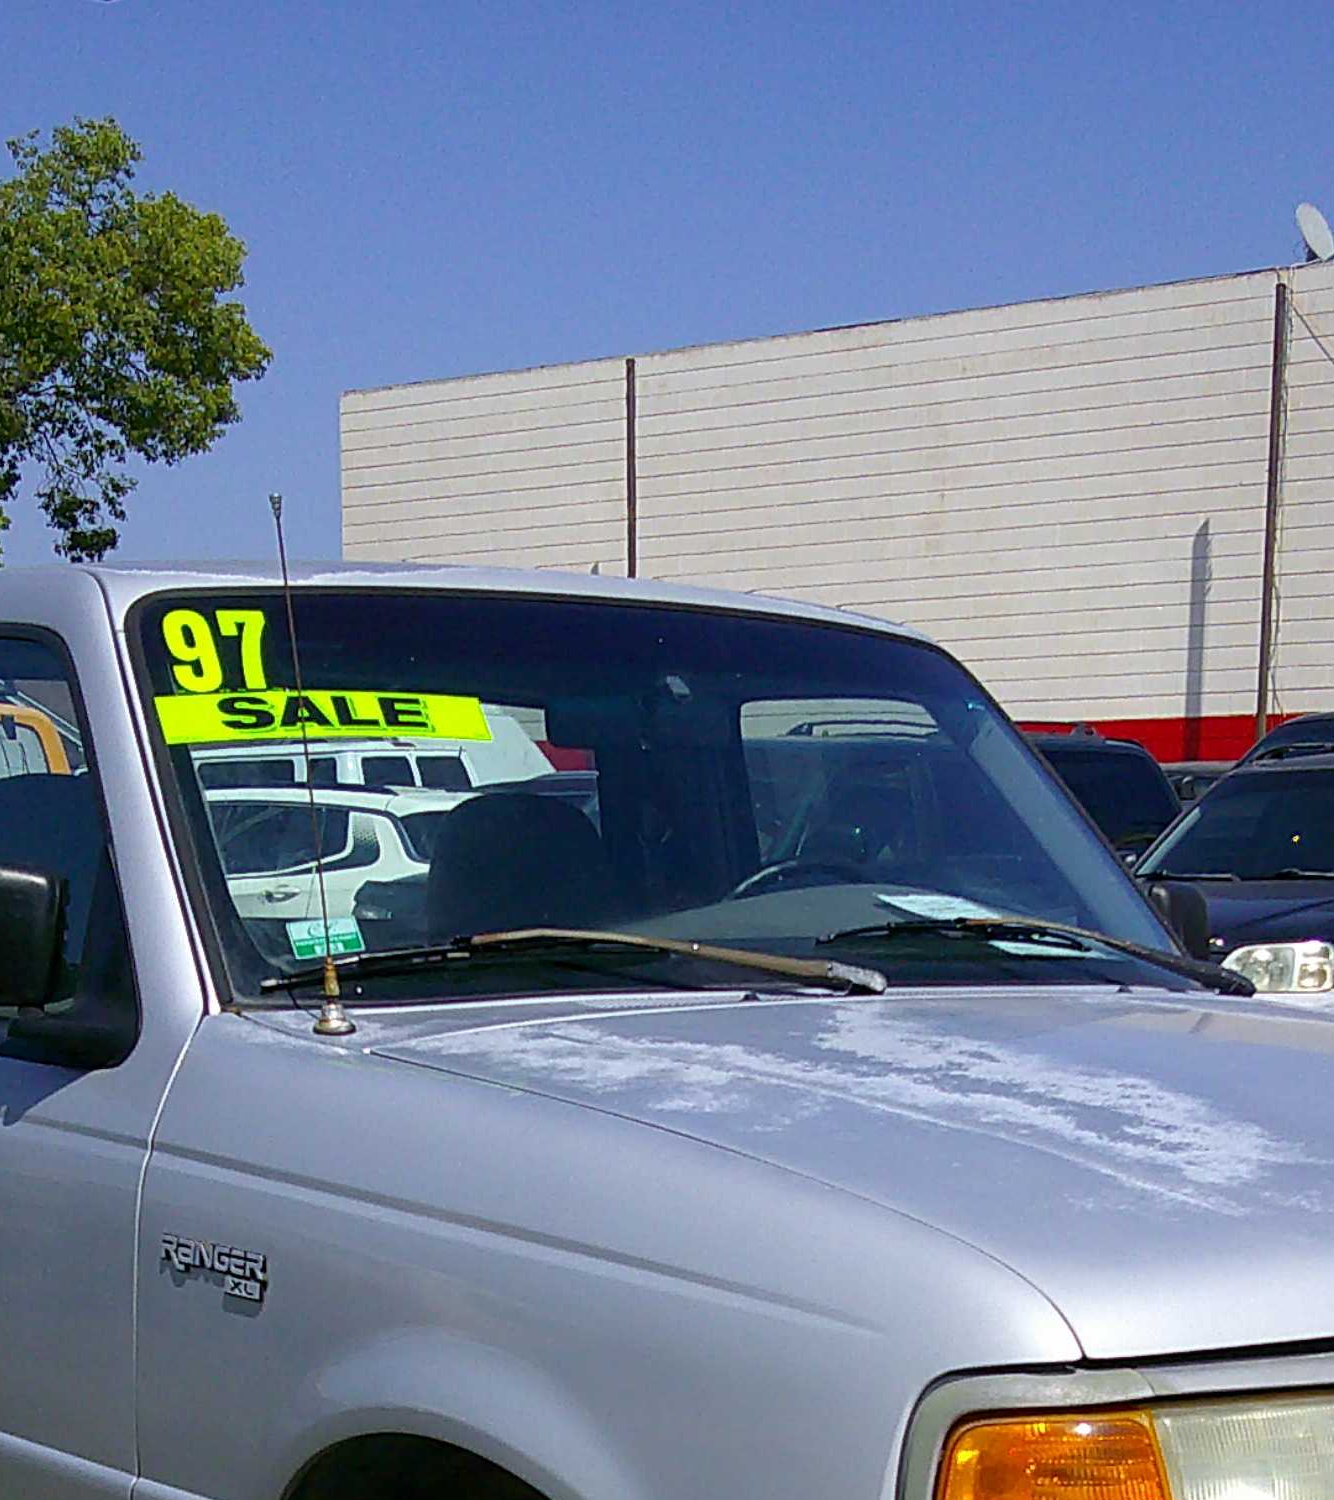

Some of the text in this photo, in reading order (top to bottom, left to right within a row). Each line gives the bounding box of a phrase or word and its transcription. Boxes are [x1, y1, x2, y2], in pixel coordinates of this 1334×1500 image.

[162, 609, 267, 693] 97
[217, 695, 434, 734] SALE
[161, 1232, 268, 1282] RANGER
